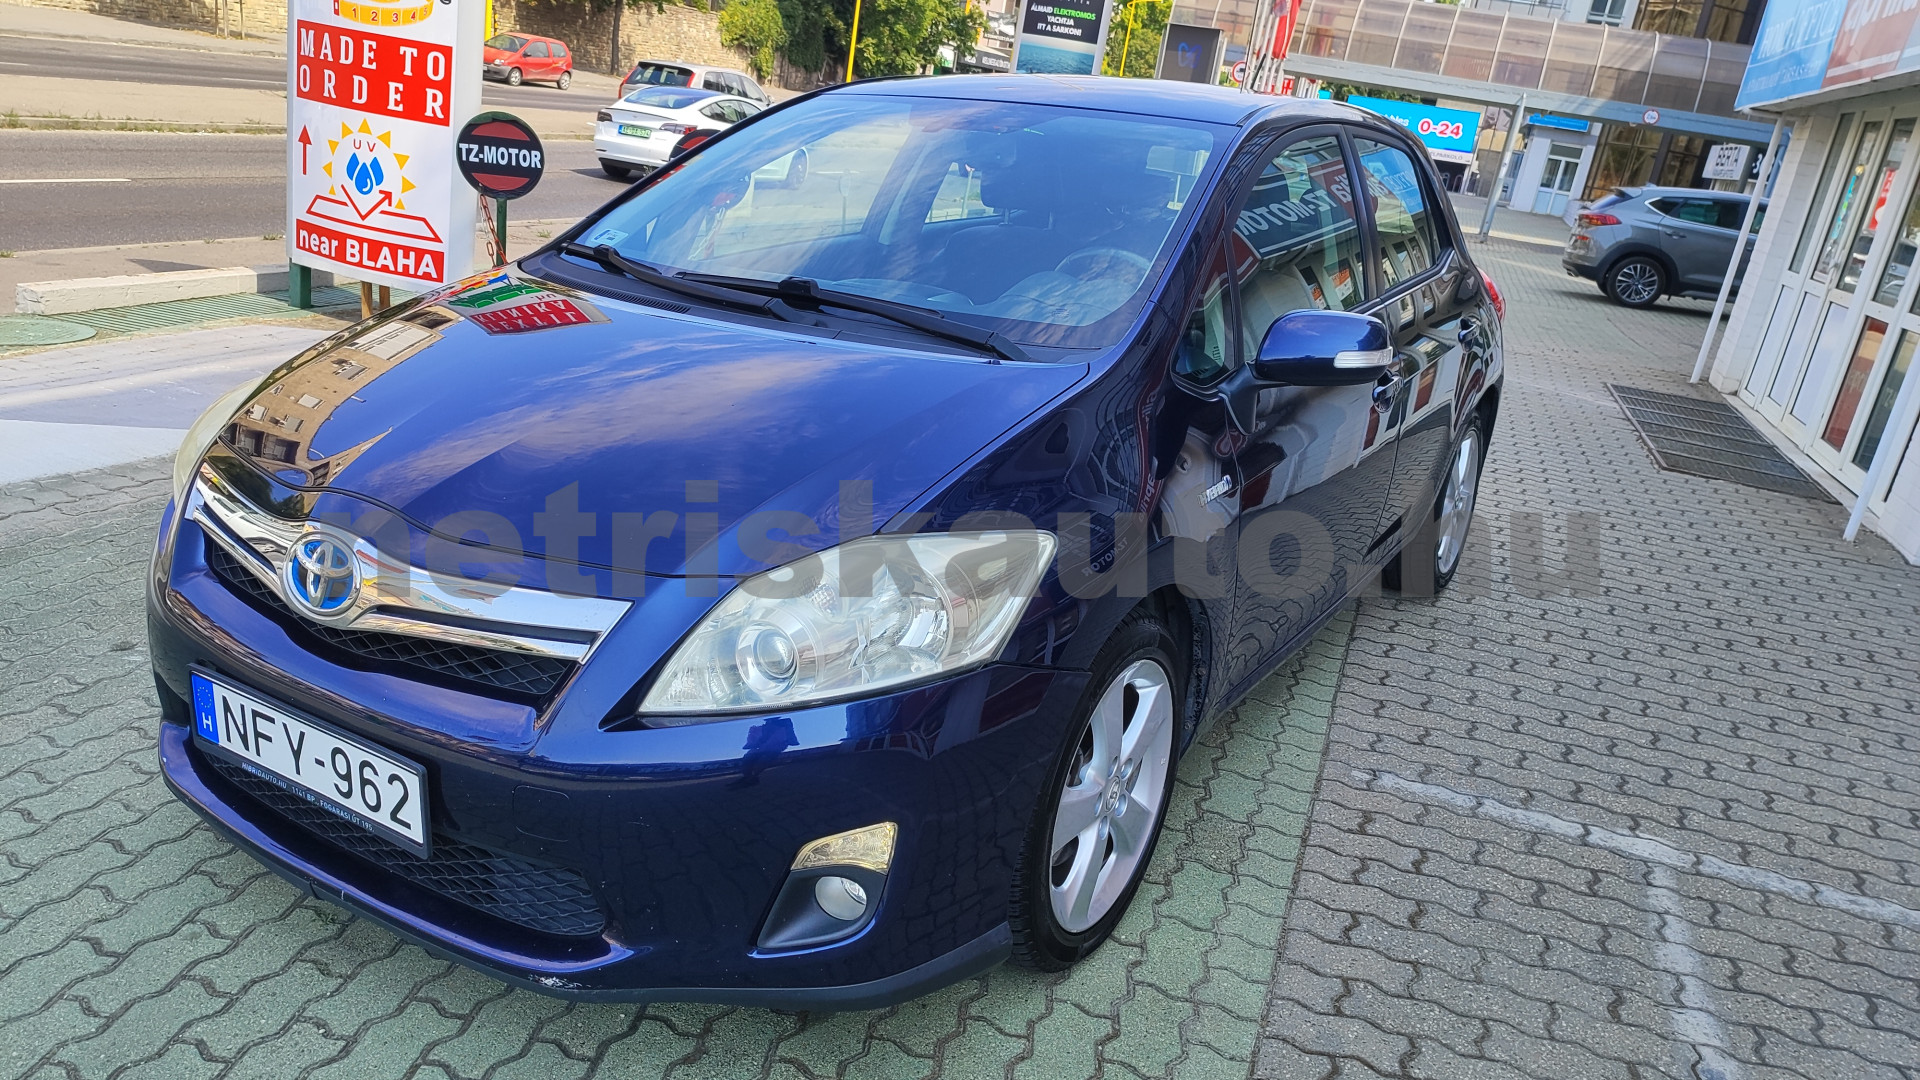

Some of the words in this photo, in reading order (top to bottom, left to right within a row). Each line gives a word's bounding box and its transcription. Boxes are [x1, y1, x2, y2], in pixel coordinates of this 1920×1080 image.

[371, 11, 378, 21] 2
[392, 13, 399, 22] 3
[410, 11, 416, 20] 4
[1054, 7, 1096, 20] ELEKTROMOS
[300, 27, 377, 70] MADE
[400, 46, 446, 81] TO
[300, 64, 444, 119] ORDER
[1418, 119, 1463, 138] 0-24
[459, 143, 542, 169] TZ-MOTOR
[299, 228, 338, 257] near
[346, 241, 437, 279] BLAHA
[201, 712, 213, 732] H
[222, 694, 412, 831] NFY-962
[241, 762, 287, 789] HIBRIDAUTO.HU
[320, 800, 351, 821] FOGARASI
